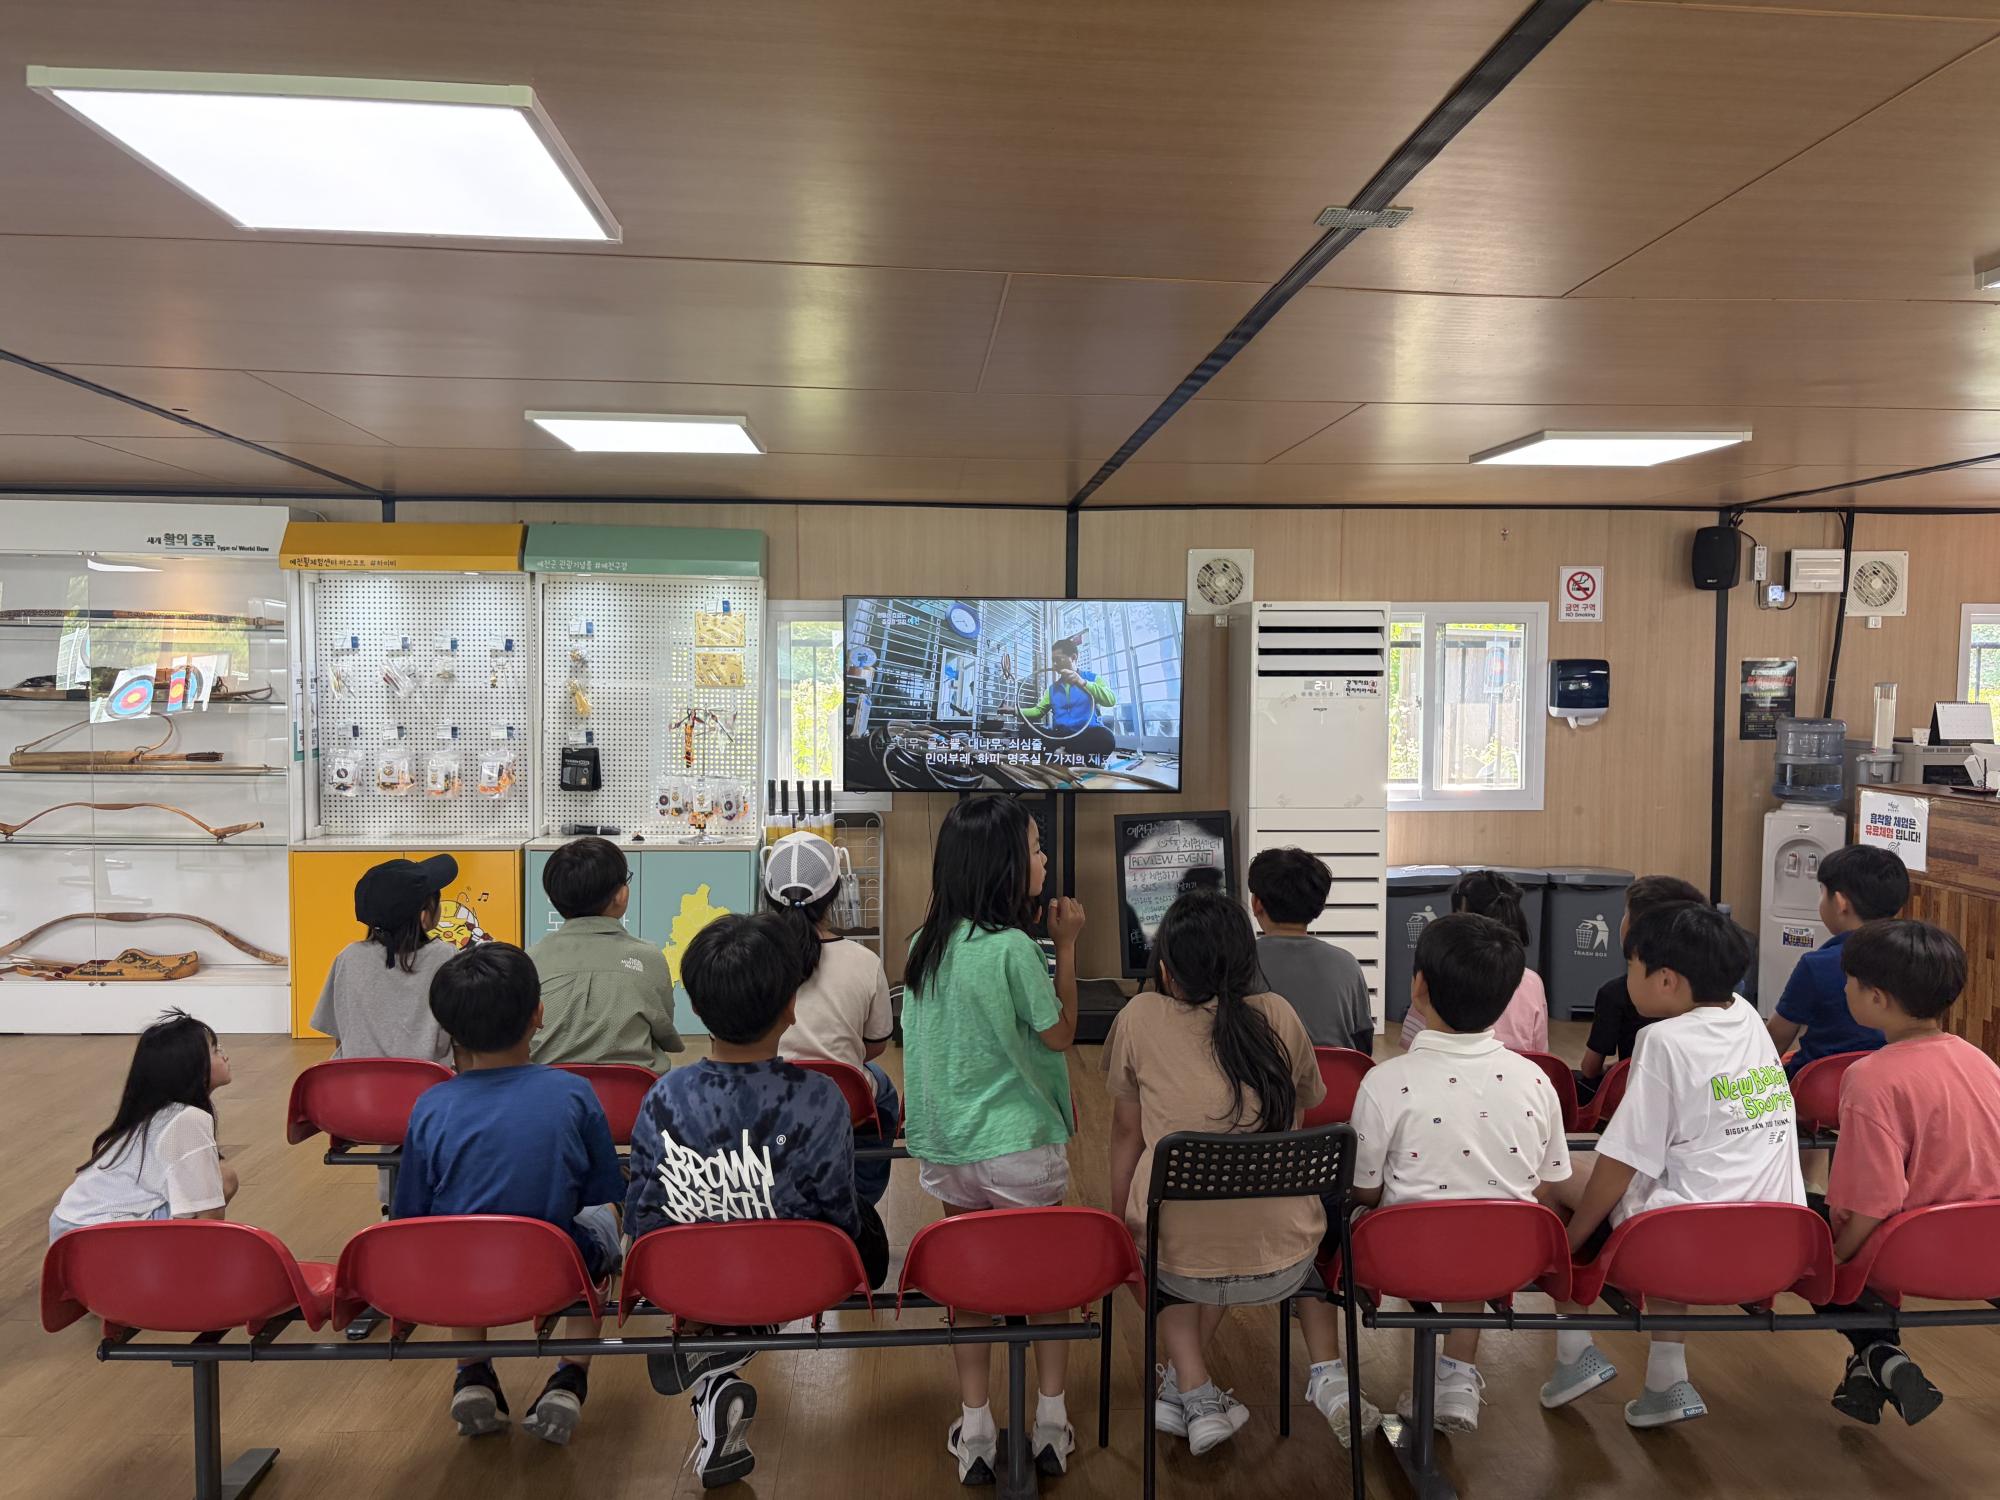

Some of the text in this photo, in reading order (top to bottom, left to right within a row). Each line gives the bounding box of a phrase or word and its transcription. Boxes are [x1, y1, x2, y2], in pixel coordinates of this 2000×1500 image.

[164, 533, 188, 546] 활의
[192, 533, 216, 546] 종류
[1565, 603, 1596, 611] 금연 구역
[967, 737, 1005, 750] 대나무,
[1008, 738, 1047, 751] 쇠심줄,
[925, 752, 974, 765] 민어부레,
[976, 752, 1004, 765] 화피,
[1007, 752, 1041, 766] 명주실
[1045, 752, 1086, 766] 7가지의
[1870, 812, 1917, 830] 흡착활 체험은
[1865, 824, 1921, 843] 유료체험 입니다!
[1131, 852, 1212, 867] REVIEW EVENT
[657, 1129, 775, 1194] BROWN
[659, 1175, 778, 1224] BREATH
